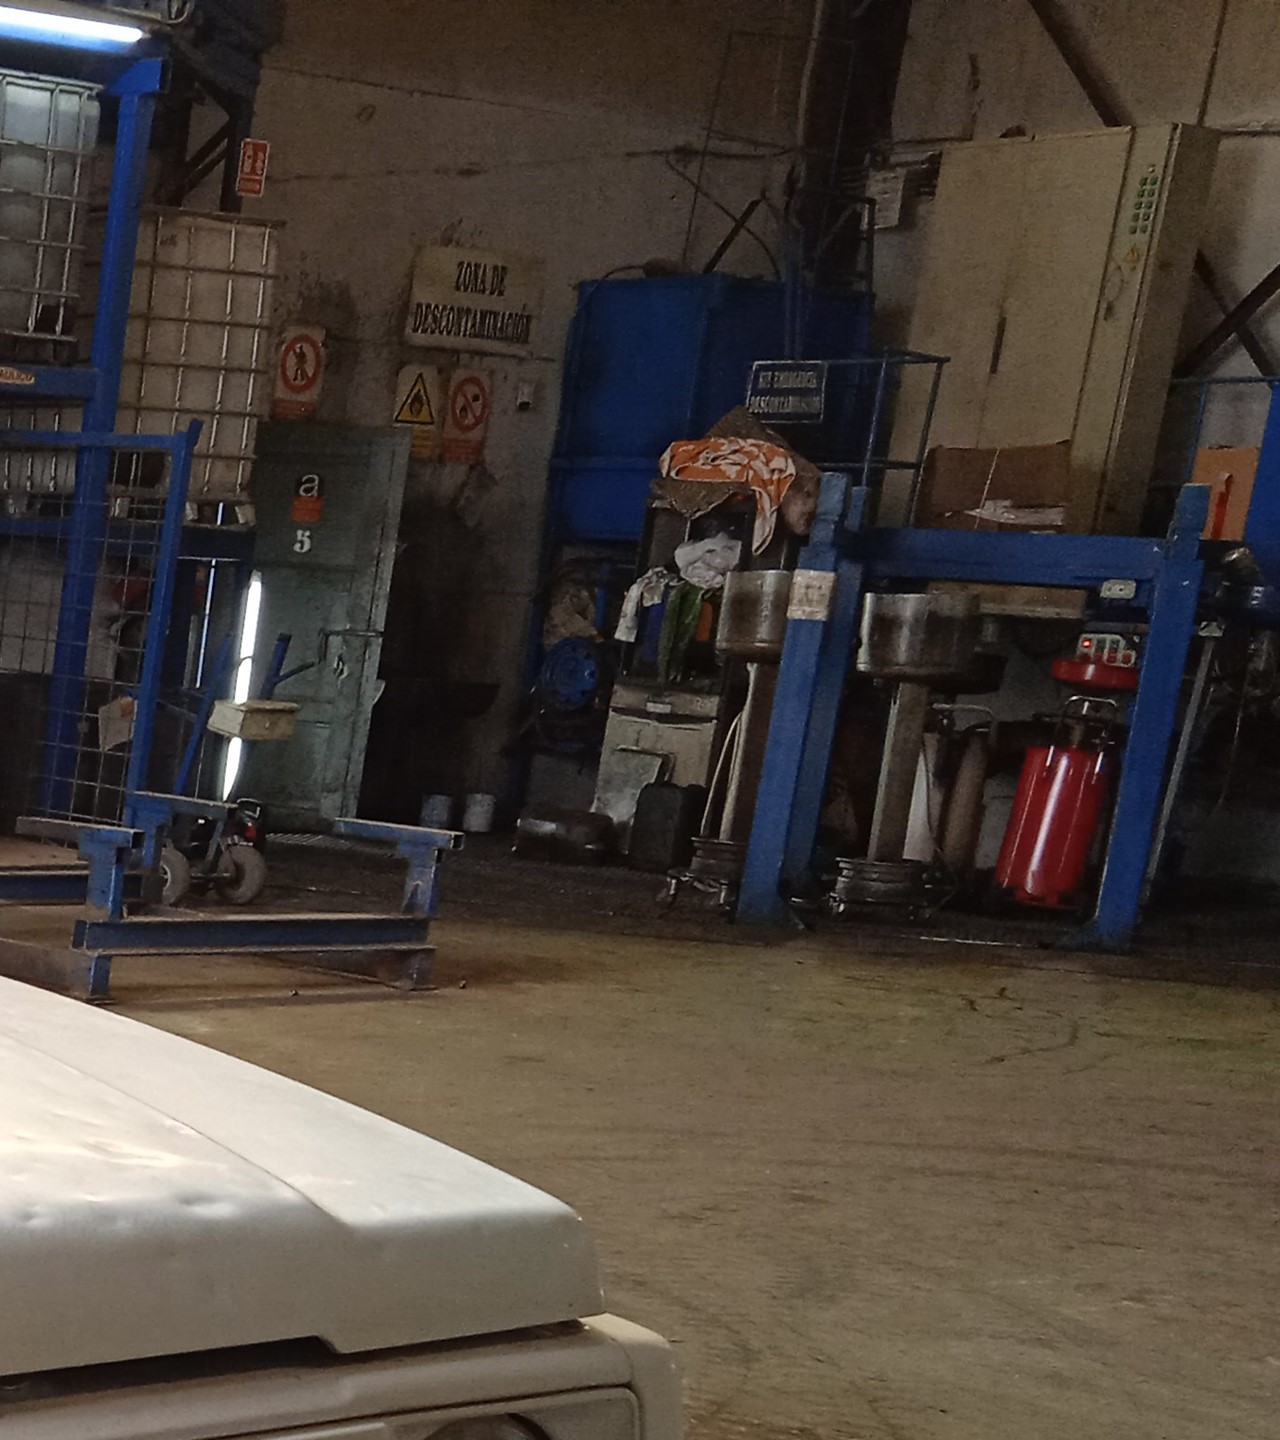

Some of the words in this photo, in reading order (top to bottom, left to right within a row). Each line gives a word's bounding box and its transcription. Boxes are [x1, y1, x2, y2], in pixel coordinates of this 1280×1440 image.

[455, 260, 488, 295] ZONA
[489, 264, 508, 297] DE
[293, 529, 312, 553] 5
